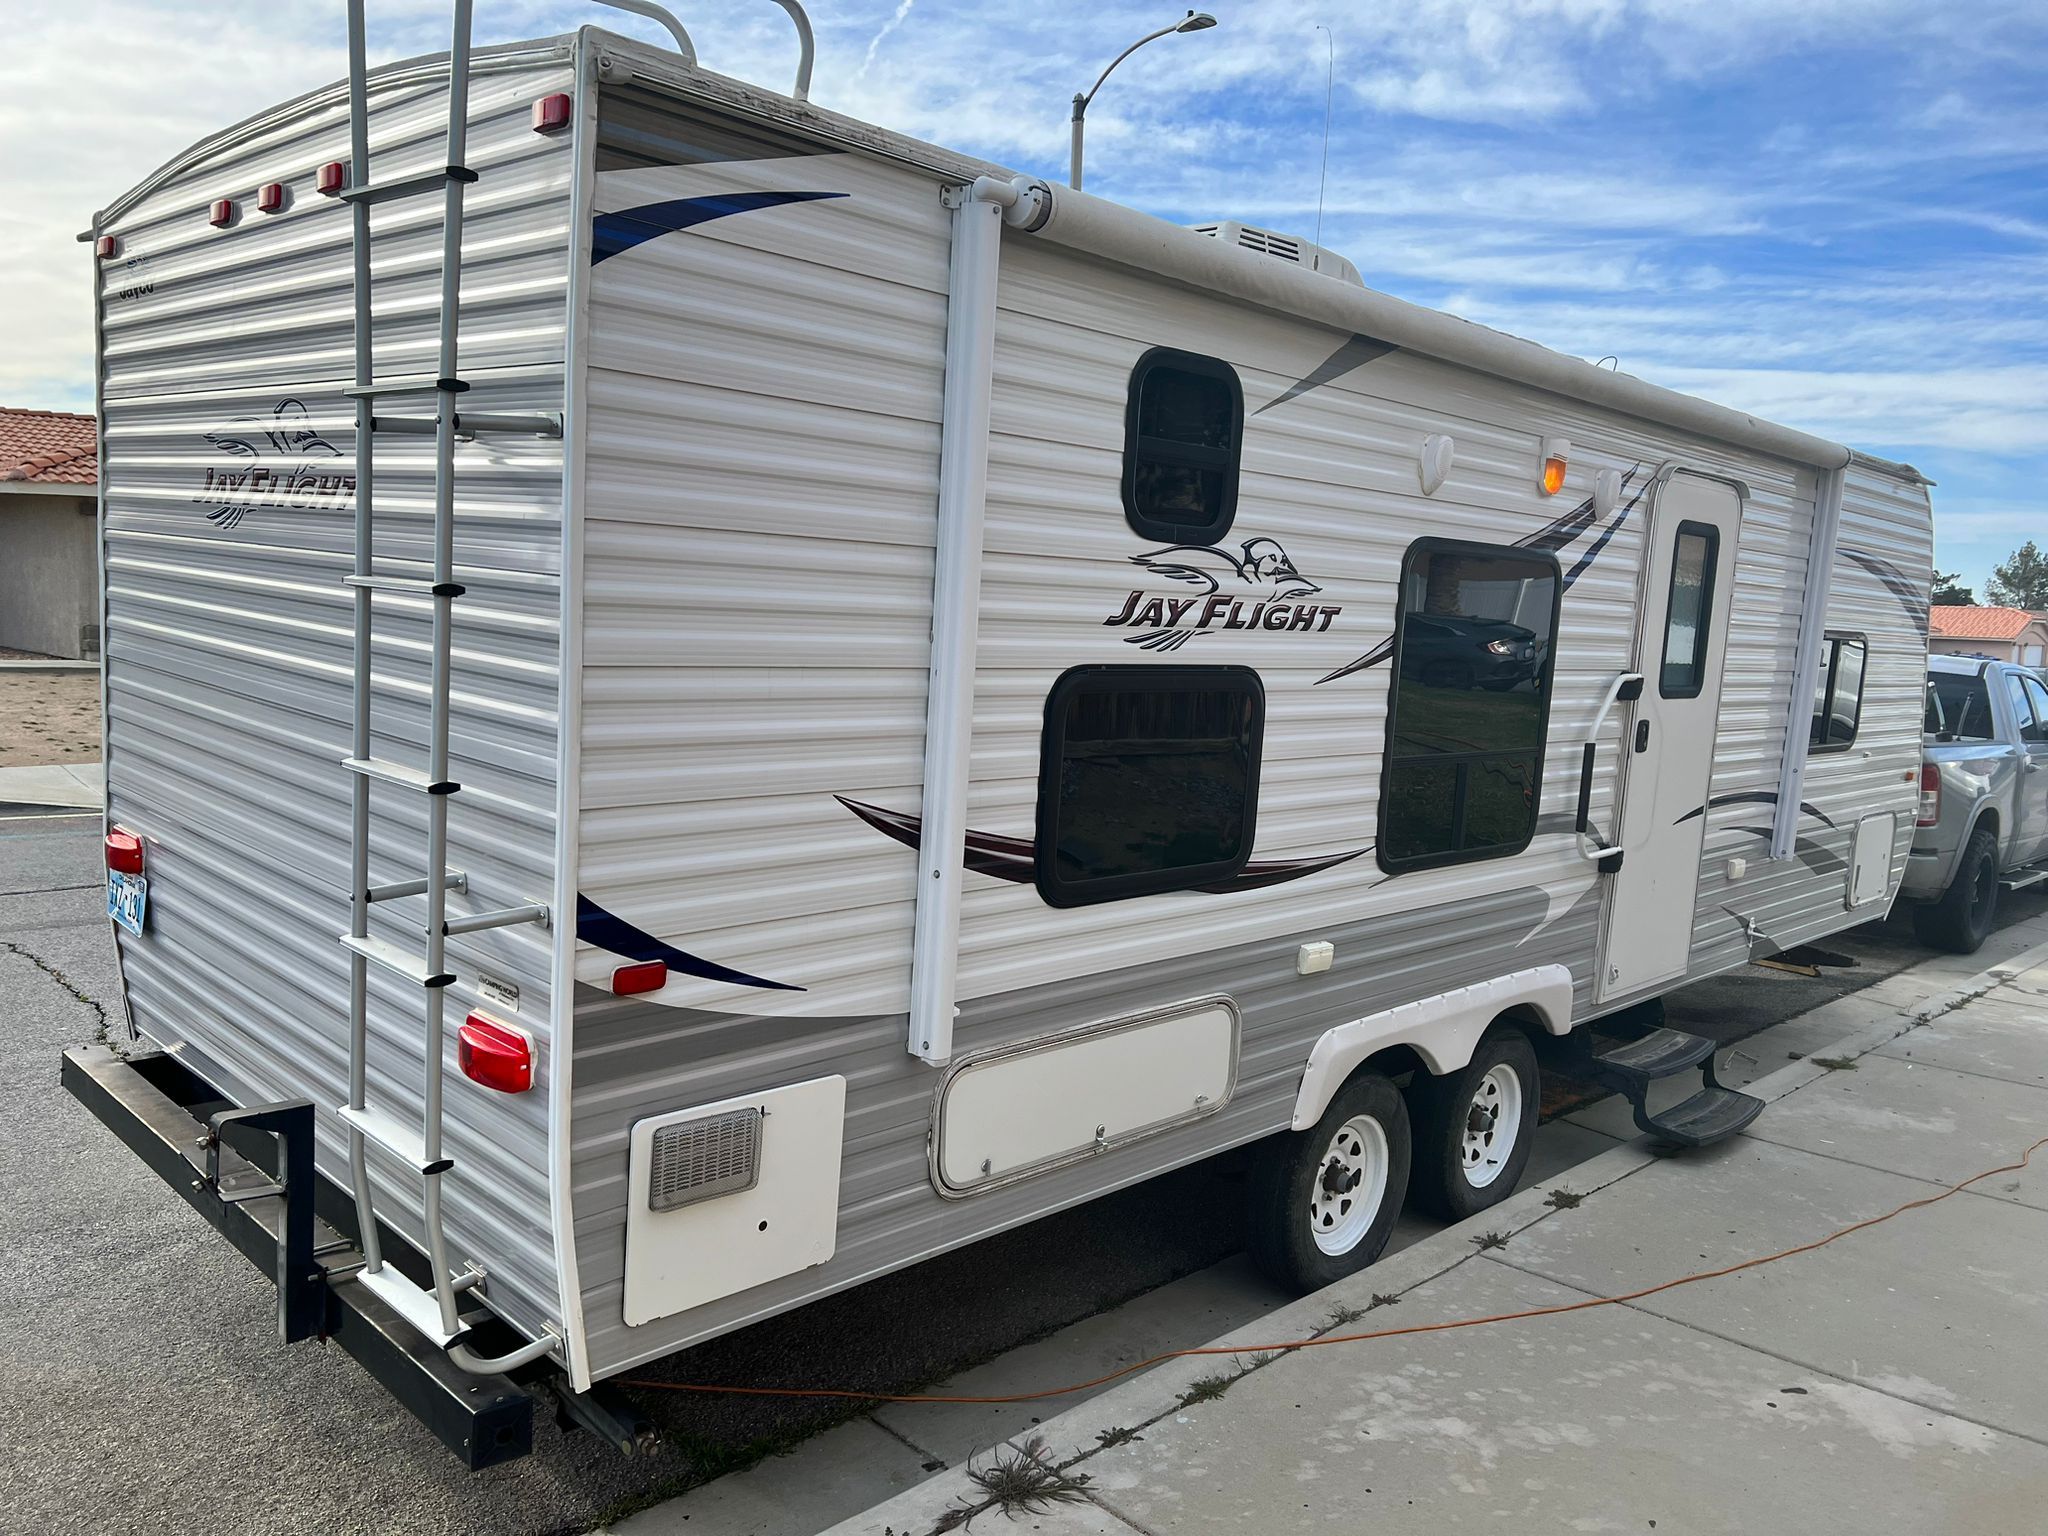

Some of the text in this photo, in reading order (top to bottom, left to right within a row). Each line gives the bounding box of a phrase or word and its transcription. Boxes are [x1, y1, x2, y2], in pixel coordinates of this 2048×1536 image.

[192, 467, 357, 511] JAY FLIGHT
[1103, 590, 1343, 633] JAY FLIGHT
